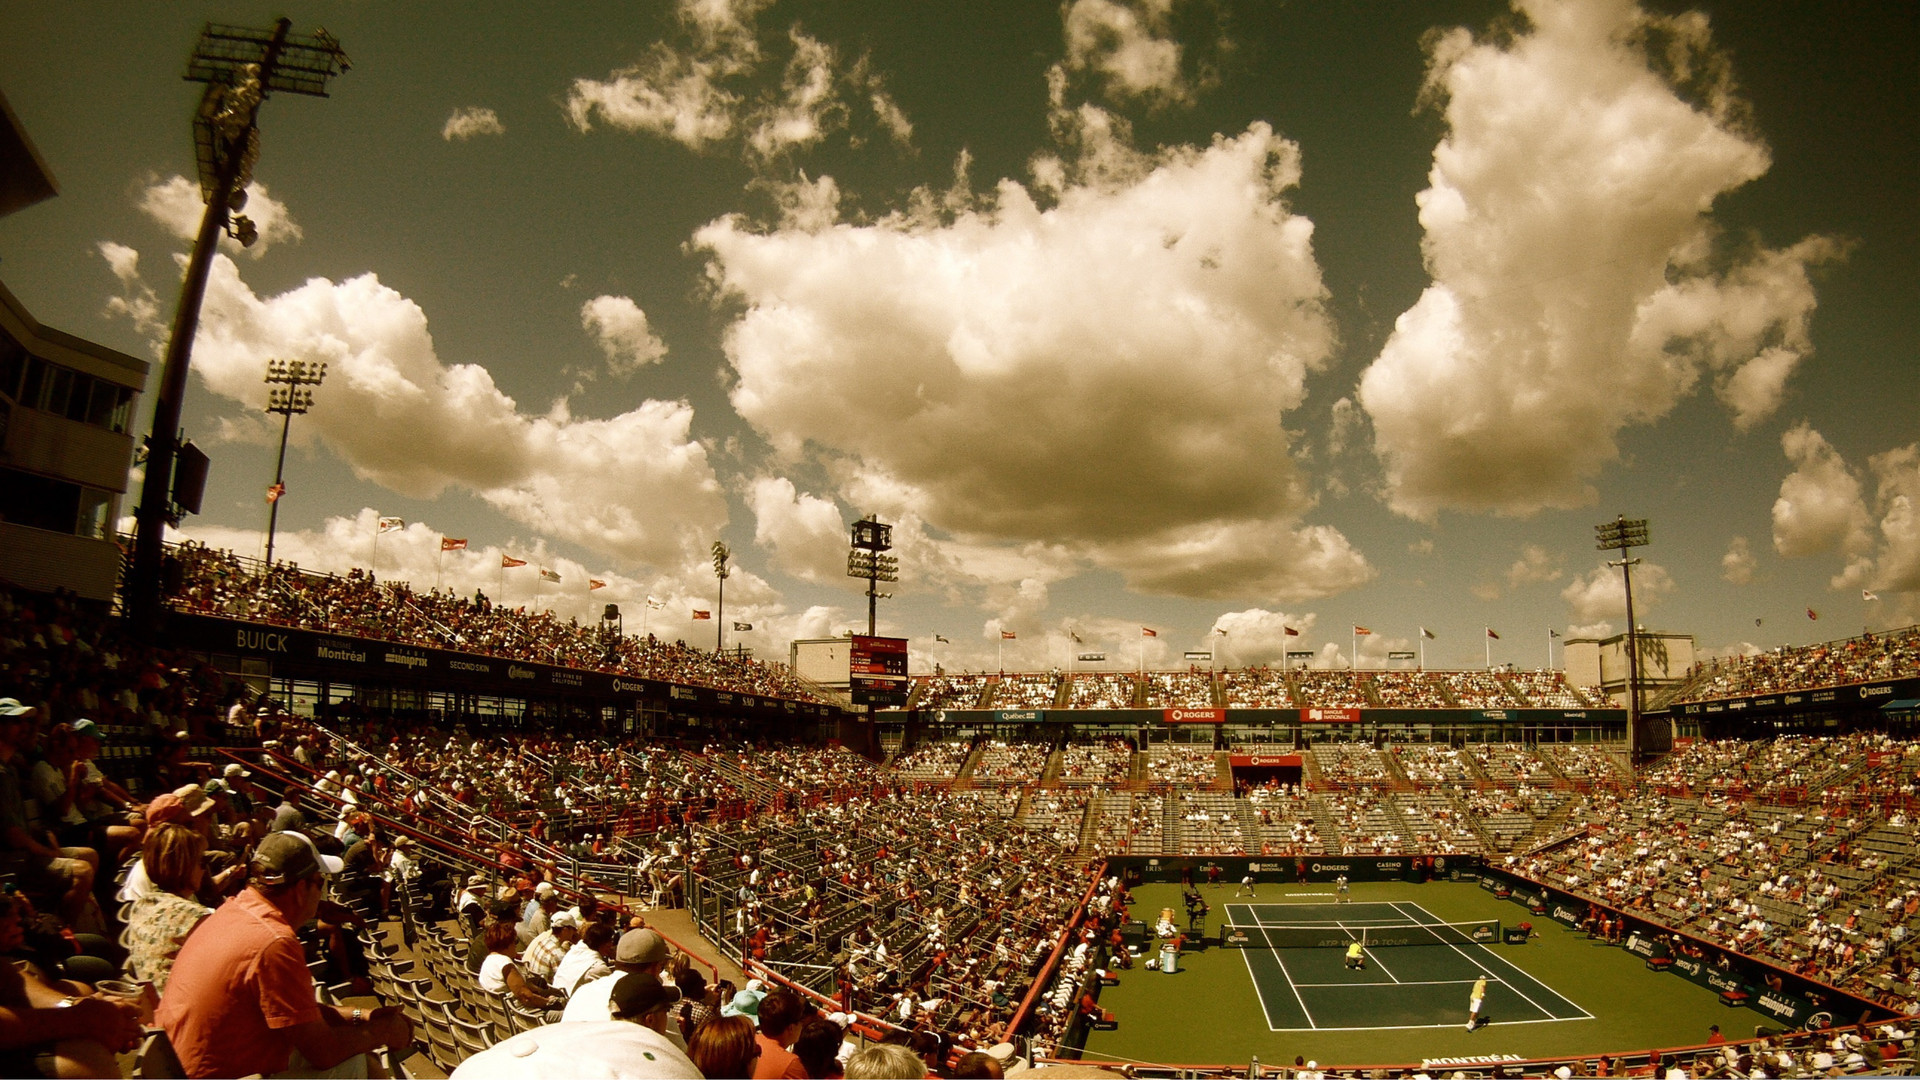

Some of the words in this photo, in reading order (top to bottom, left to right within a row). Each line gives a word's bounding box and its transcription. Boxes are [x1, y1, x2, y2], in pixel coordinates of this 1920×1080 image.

[237, 629, 288, 652] BUICK
[317, 646, 366, 663] Montréal
[394, 656, 428, 670] uniprix
[621, 682, 645, 692] ROGERS
[1868, 686, 1892, 696] ROGERS
[1001, 712, 1026, 720] Québec
[1183, 711, 1215, 719] ROGERS
[1558, 909, 1576, 923] ROGERS
[1317, 939, 1339, 947] ATP
[1382, 938, 1408, 946] TOUR
[1708, 974, 1727, 989] Québec
[1422, 1054, 1527, 1065] MONTRÉAL
